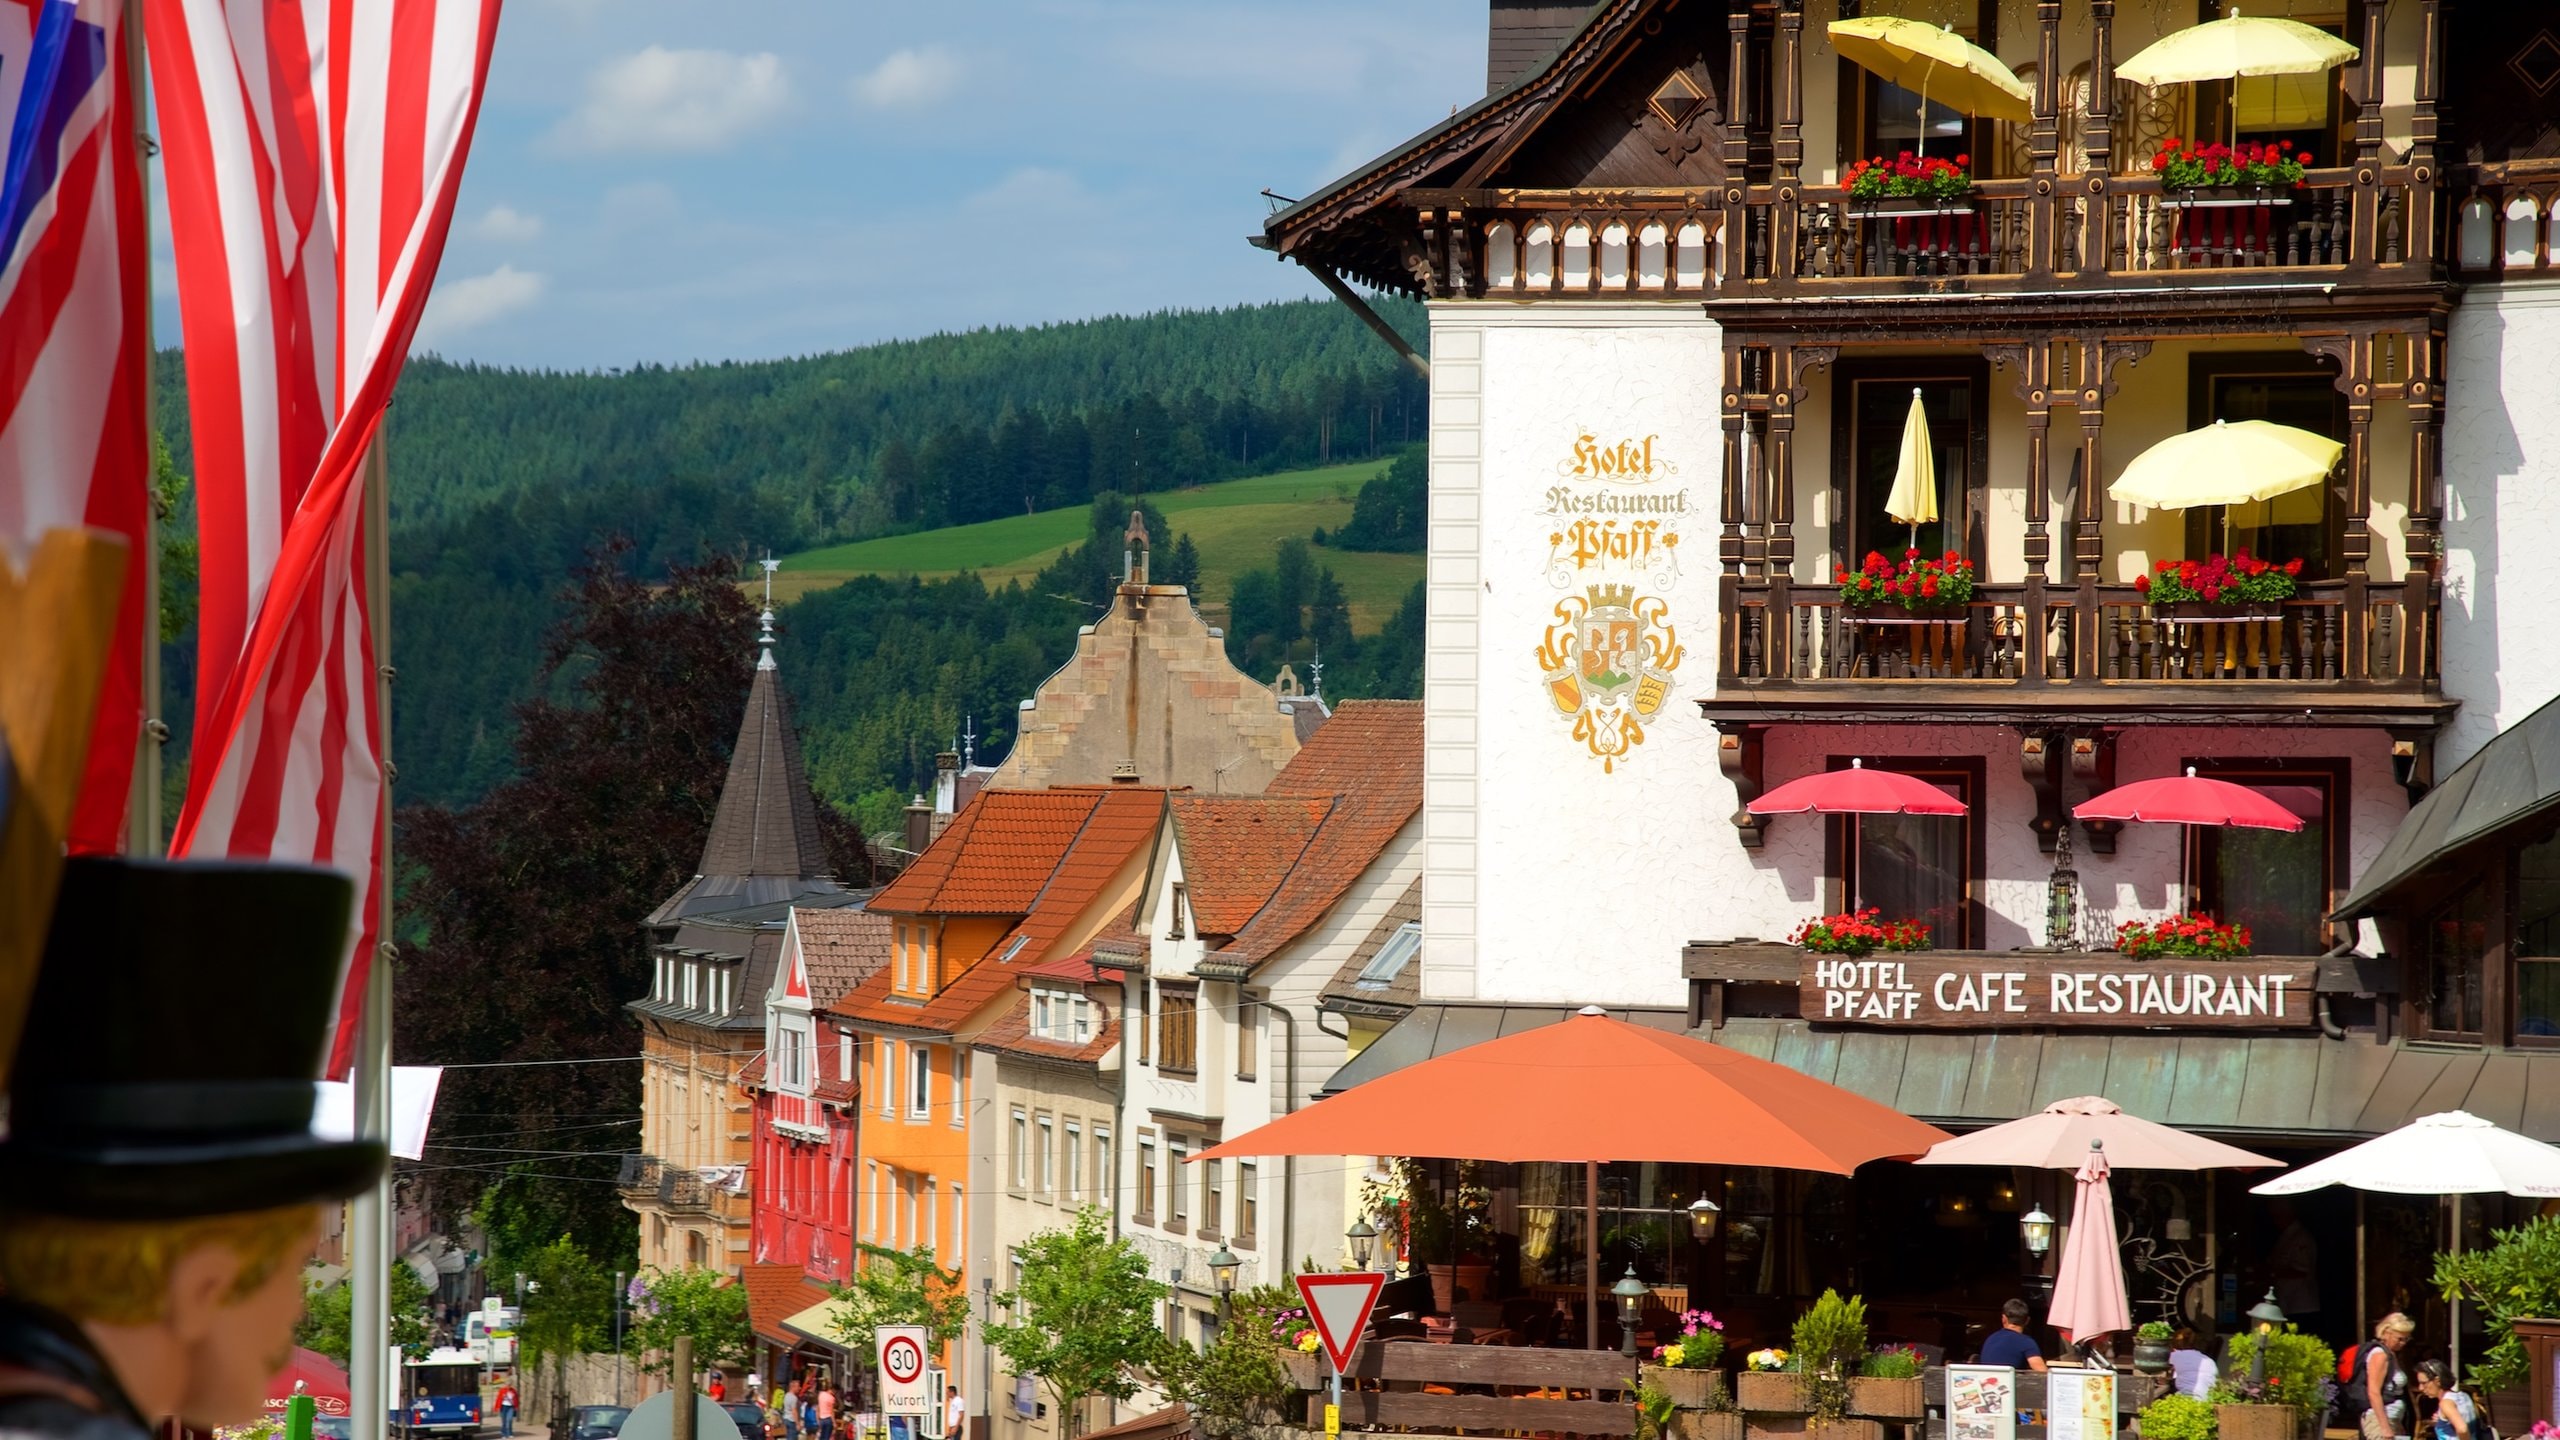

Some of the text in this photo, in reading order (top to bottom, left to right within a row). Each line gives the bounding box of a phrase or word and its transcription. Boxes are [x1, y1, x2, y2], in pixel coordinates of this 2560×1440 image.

[1572, 433, 1660, 479] Hotel
[1545, 486, 1690, 515] Restaurant
[1566, 519, 1662, 571] Pfaff
[1815, 960, 1914, 990] HOTEL
[1824, 989, 1922, 1020] PFAFF
[1934, 972, 2294, 1018] CAFE RESTAURANT
[891, 1349, 914, 1370] 30
[888, 1394, 926, 1406] Kurort
